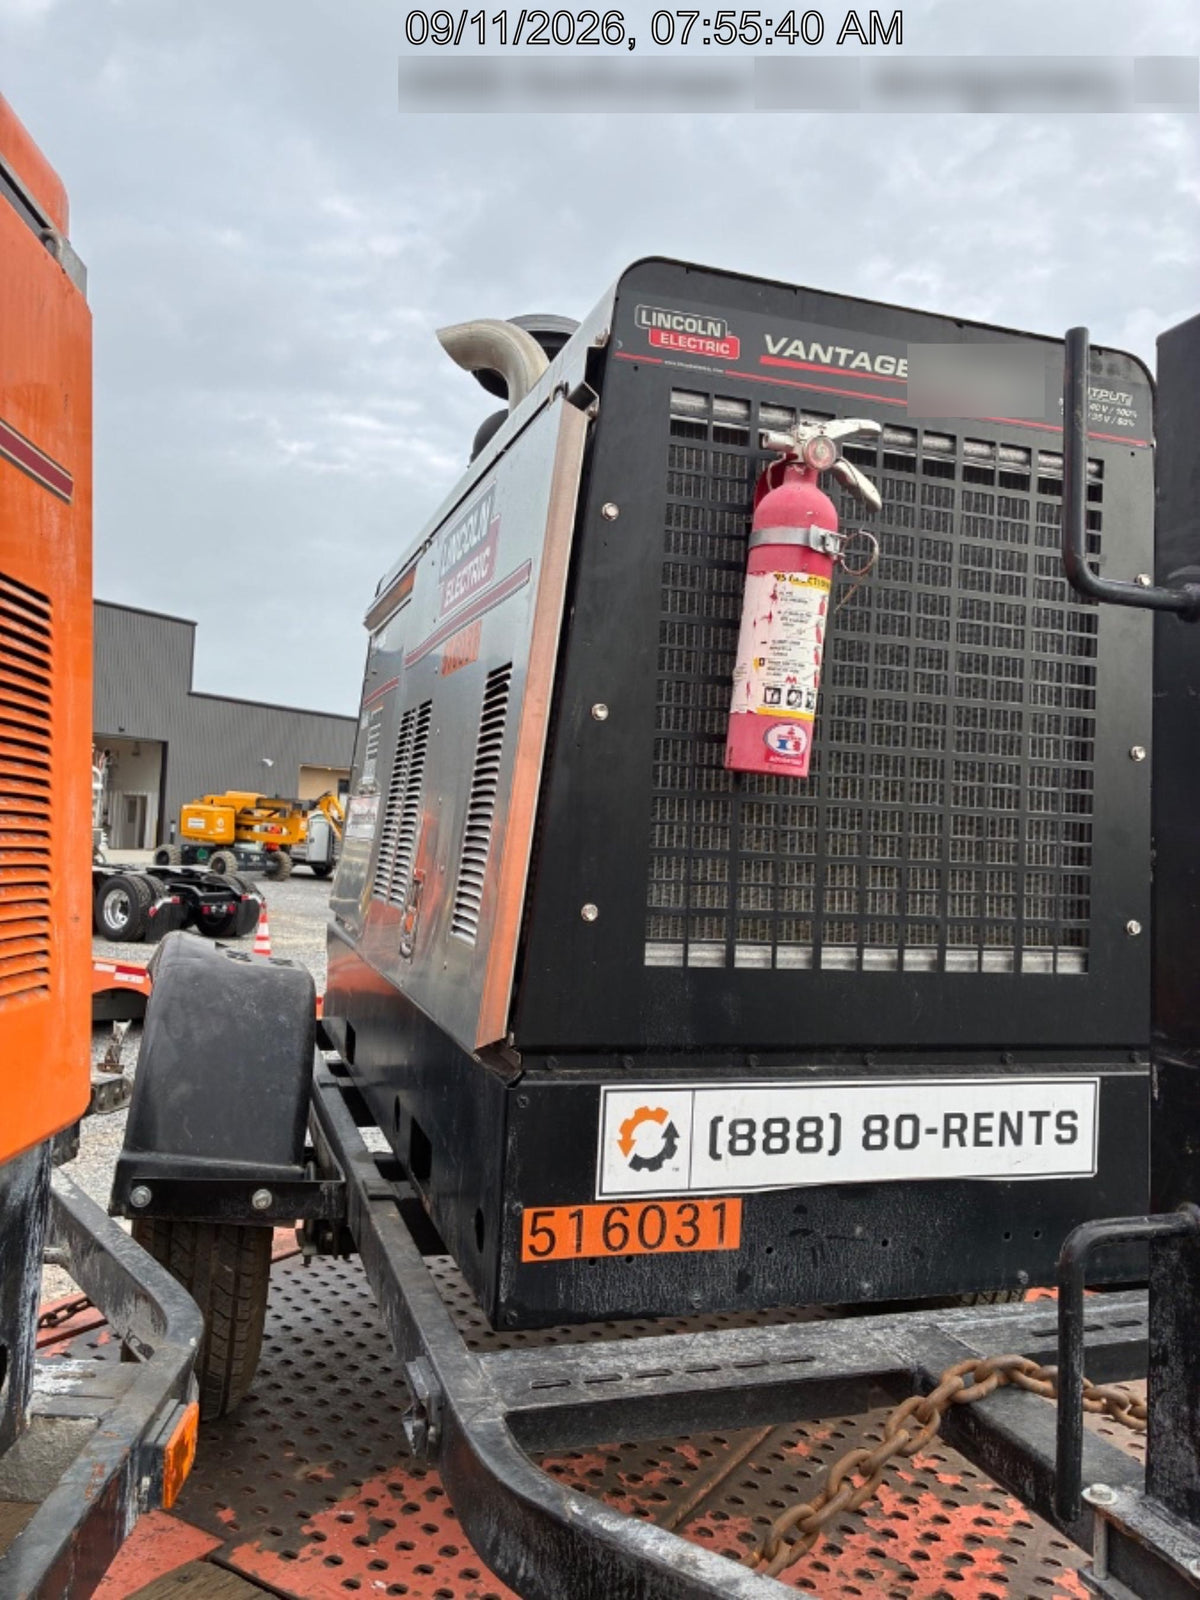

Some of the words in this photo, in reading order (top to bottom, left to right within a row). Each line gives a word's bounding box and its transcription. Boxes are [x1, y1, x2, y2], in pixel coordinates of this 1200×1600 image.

[640, 310, 721, 338] LINCOLN
[660, 333, 730, 355] ELECTRIC
[763, 333, 908, 378] VANTAGE
[443, 546, 492, 609] ELECTRIC
[708, 1112, 843, 1161] (888)
[861, 1109, 1079, 1151] 80-RENTS
[528, 1202, 727, 1259] 516031
